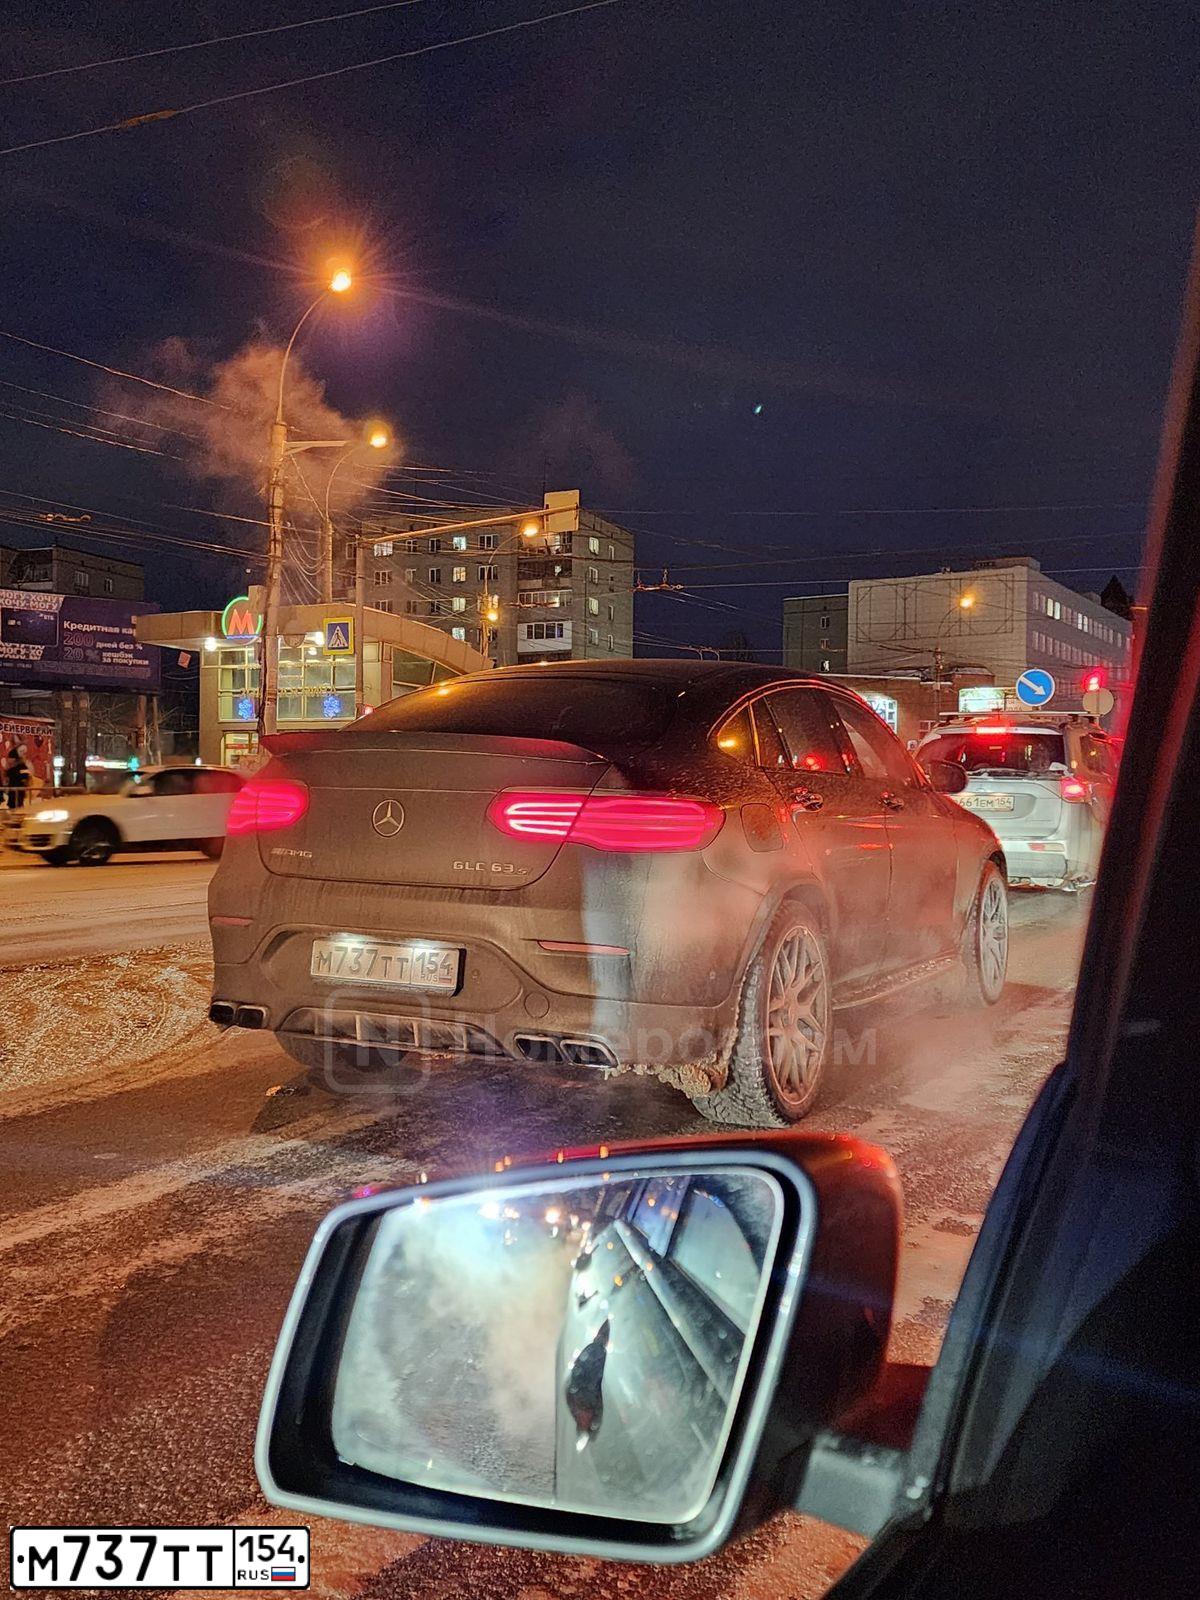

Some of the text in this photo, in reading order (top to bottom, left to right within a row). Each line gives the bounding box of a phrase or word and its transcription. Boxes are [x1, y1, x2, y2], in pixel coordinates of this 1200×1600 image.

[63, 620, 120, 634] Кредитная
[228, 609, 255, 635] М
[63, 631, 94, 647] 200
[96, 641, 117, 649] дней
[119, 641, 134, 649] без
[64, 646, 84, 660] 20
[102, 651, 134, 659] кешбэк
[113, 658, 149, 666] покупки
[955, 797, 994, 808] 661ЕМ
[453, 861, 486, 872] GLC
[317, 946, 453, 980] М737ТТ 154
[421, 973, 438, 983] RUS
